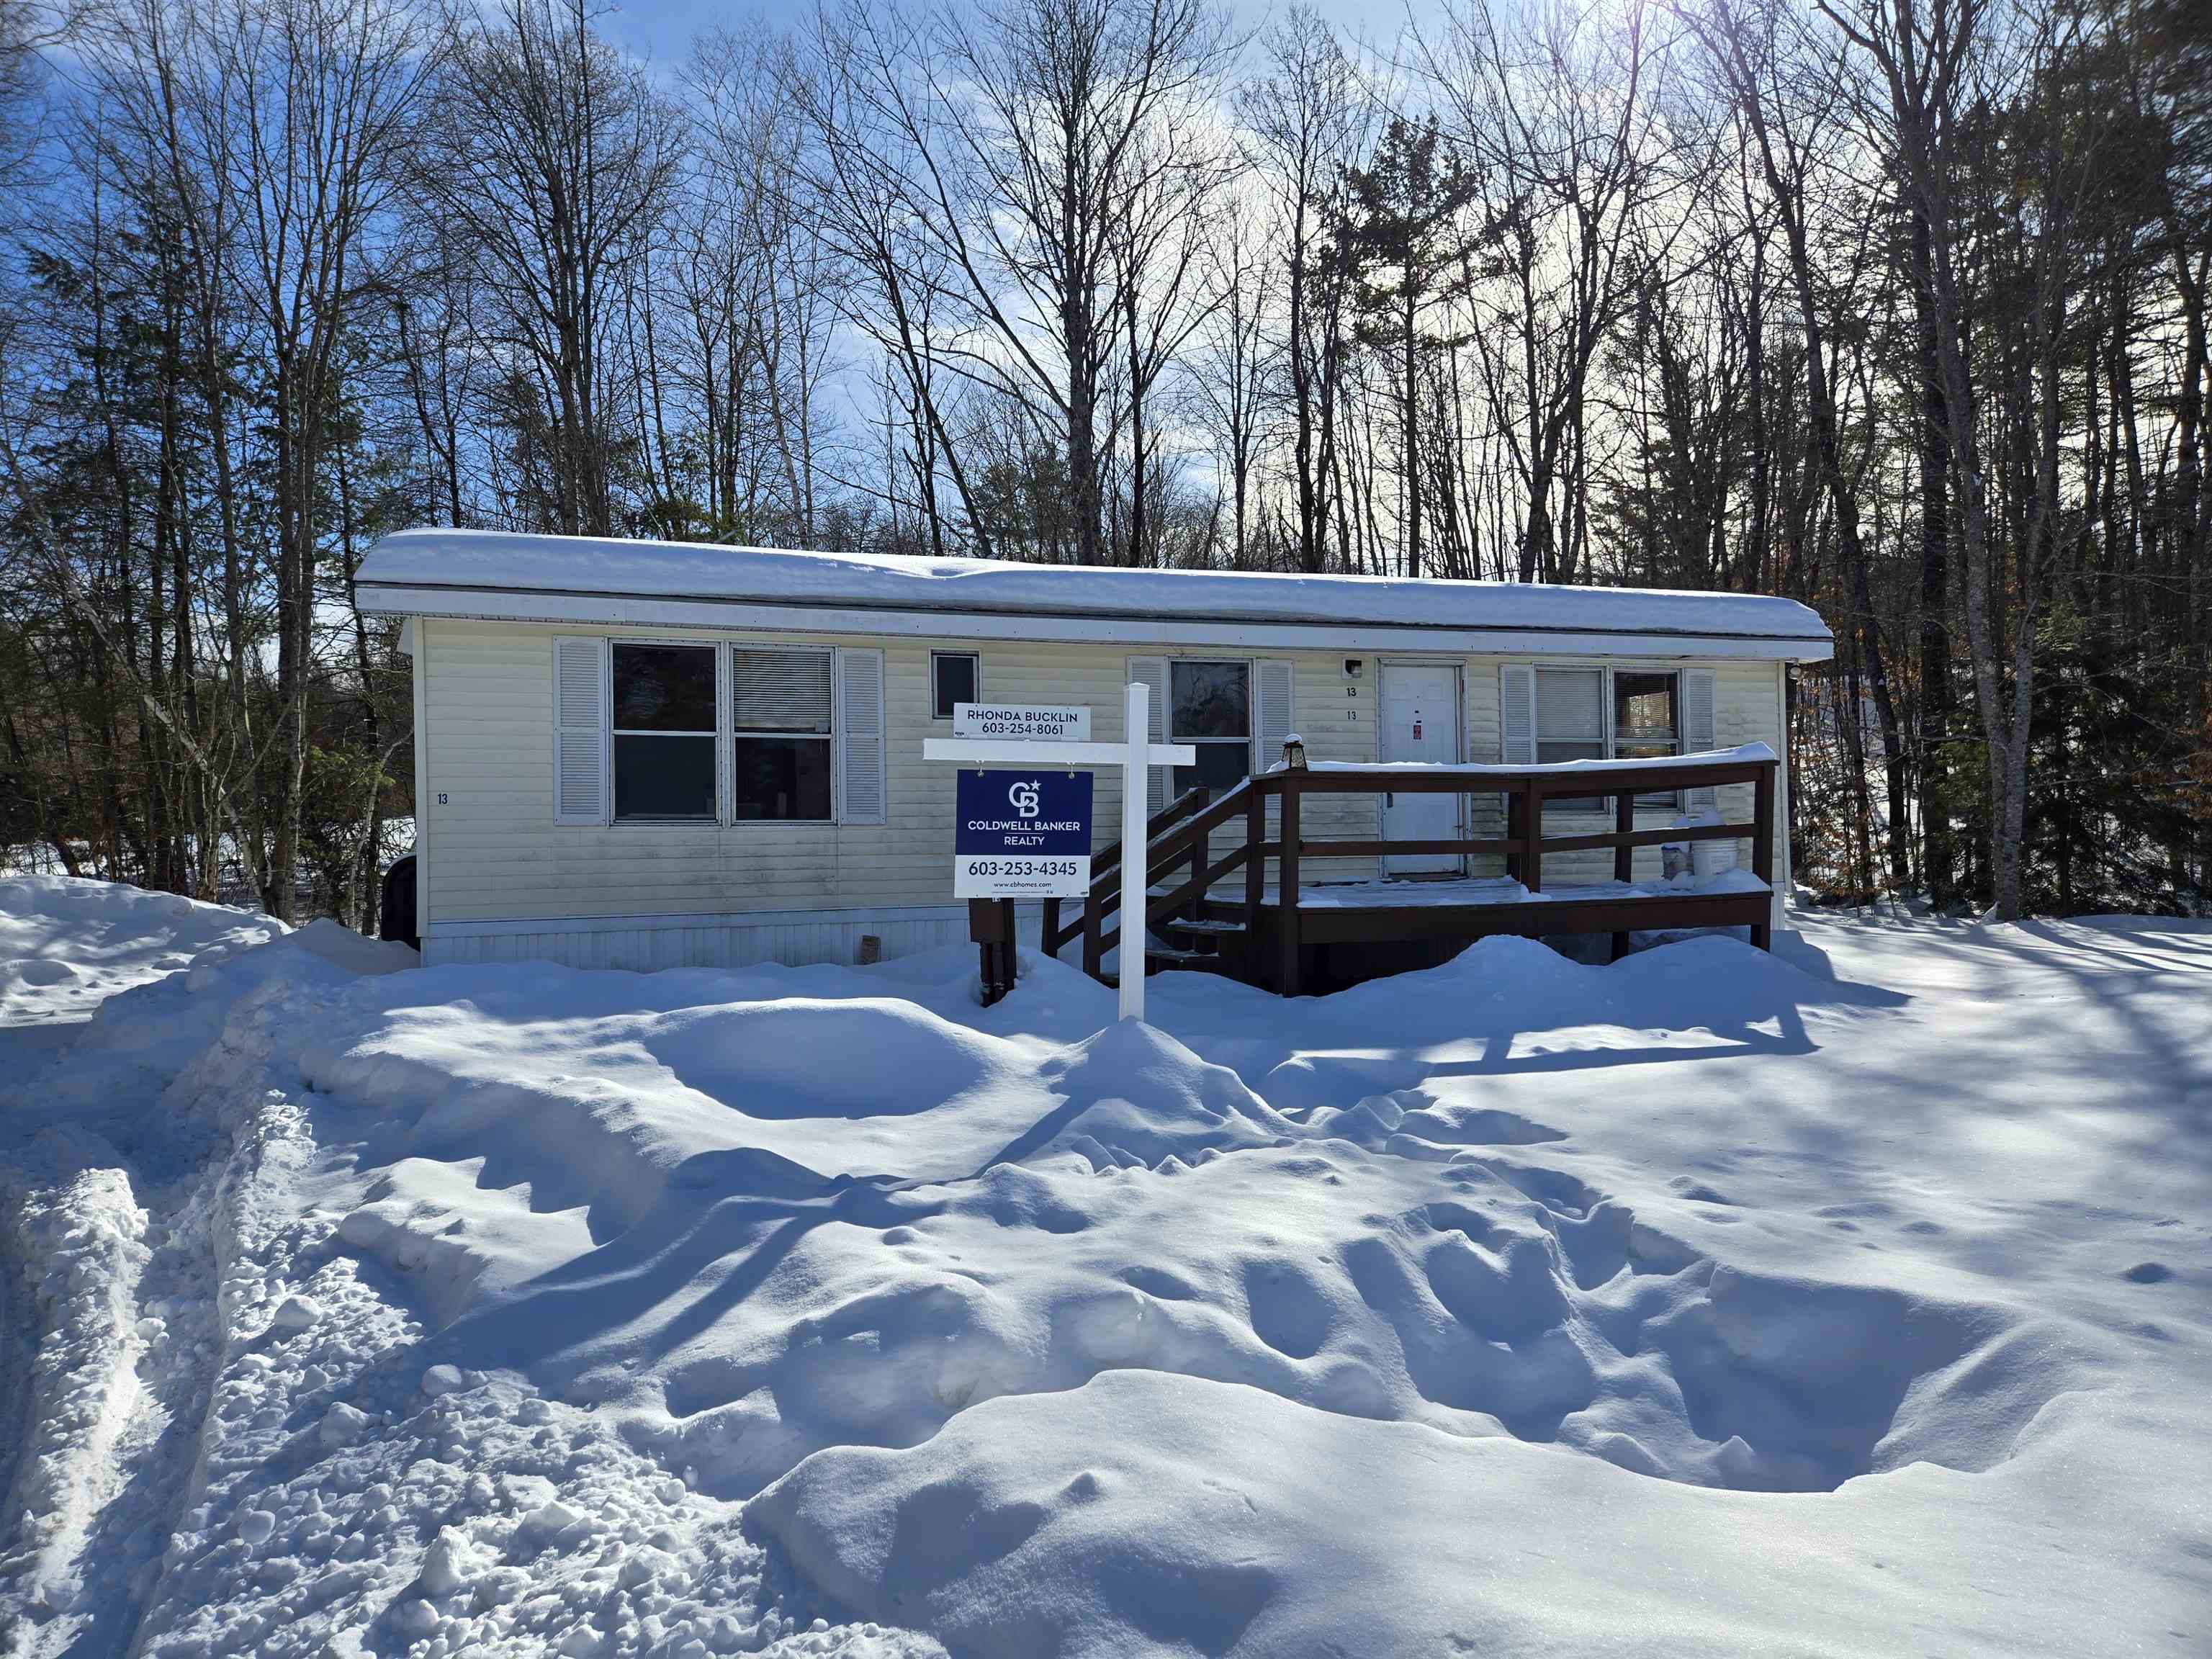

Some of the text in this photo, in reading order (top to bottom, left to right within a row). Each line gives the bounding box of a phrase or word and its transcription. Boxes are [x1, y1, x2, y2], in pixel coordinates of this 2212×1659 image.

[1346, 688, 1357, 696] 13
[968, 710, 1077, 722] RHONDA BUCKLIN
[1347, 711, 1357, 720] 13
[982, 722, 1063, 735] 603-254-8061
[438, 793, 448, 804] 13
[968, 821, 1080, 831] COLDWELL BANKER
[1004, 837, 1044, 845] REALTY
[968, 862, 1076, 876] 603-253-4345
